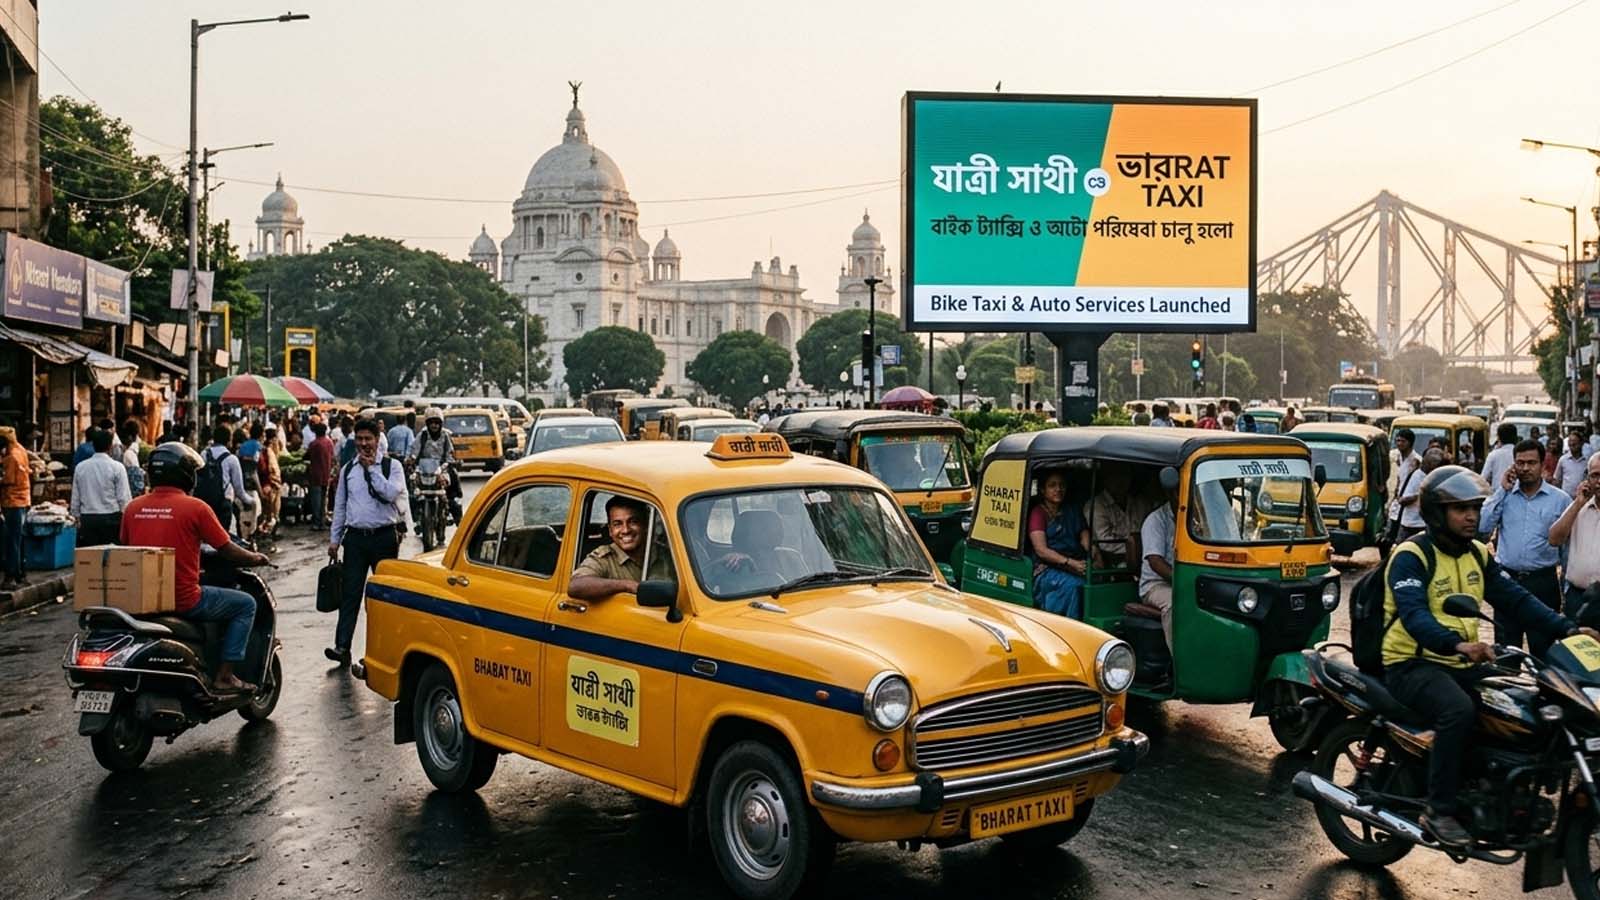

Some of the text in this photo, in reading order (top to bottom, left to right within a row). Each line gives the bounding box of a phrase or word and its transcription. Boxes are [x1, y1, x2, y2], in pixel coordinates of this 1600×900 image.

[930, 153, 1078, 195] যাত্রী সাথী
[1141, 184, 1203, 208] TAXI
[930, 214, 1234, 244] বাইক ট্যাক্সি ও অটো পরিষেবা চালু হলো
[931, 294, 1231, 313] Bike Taxi & Auto Services Launched
[511, 666, 532, 688] TAXI
